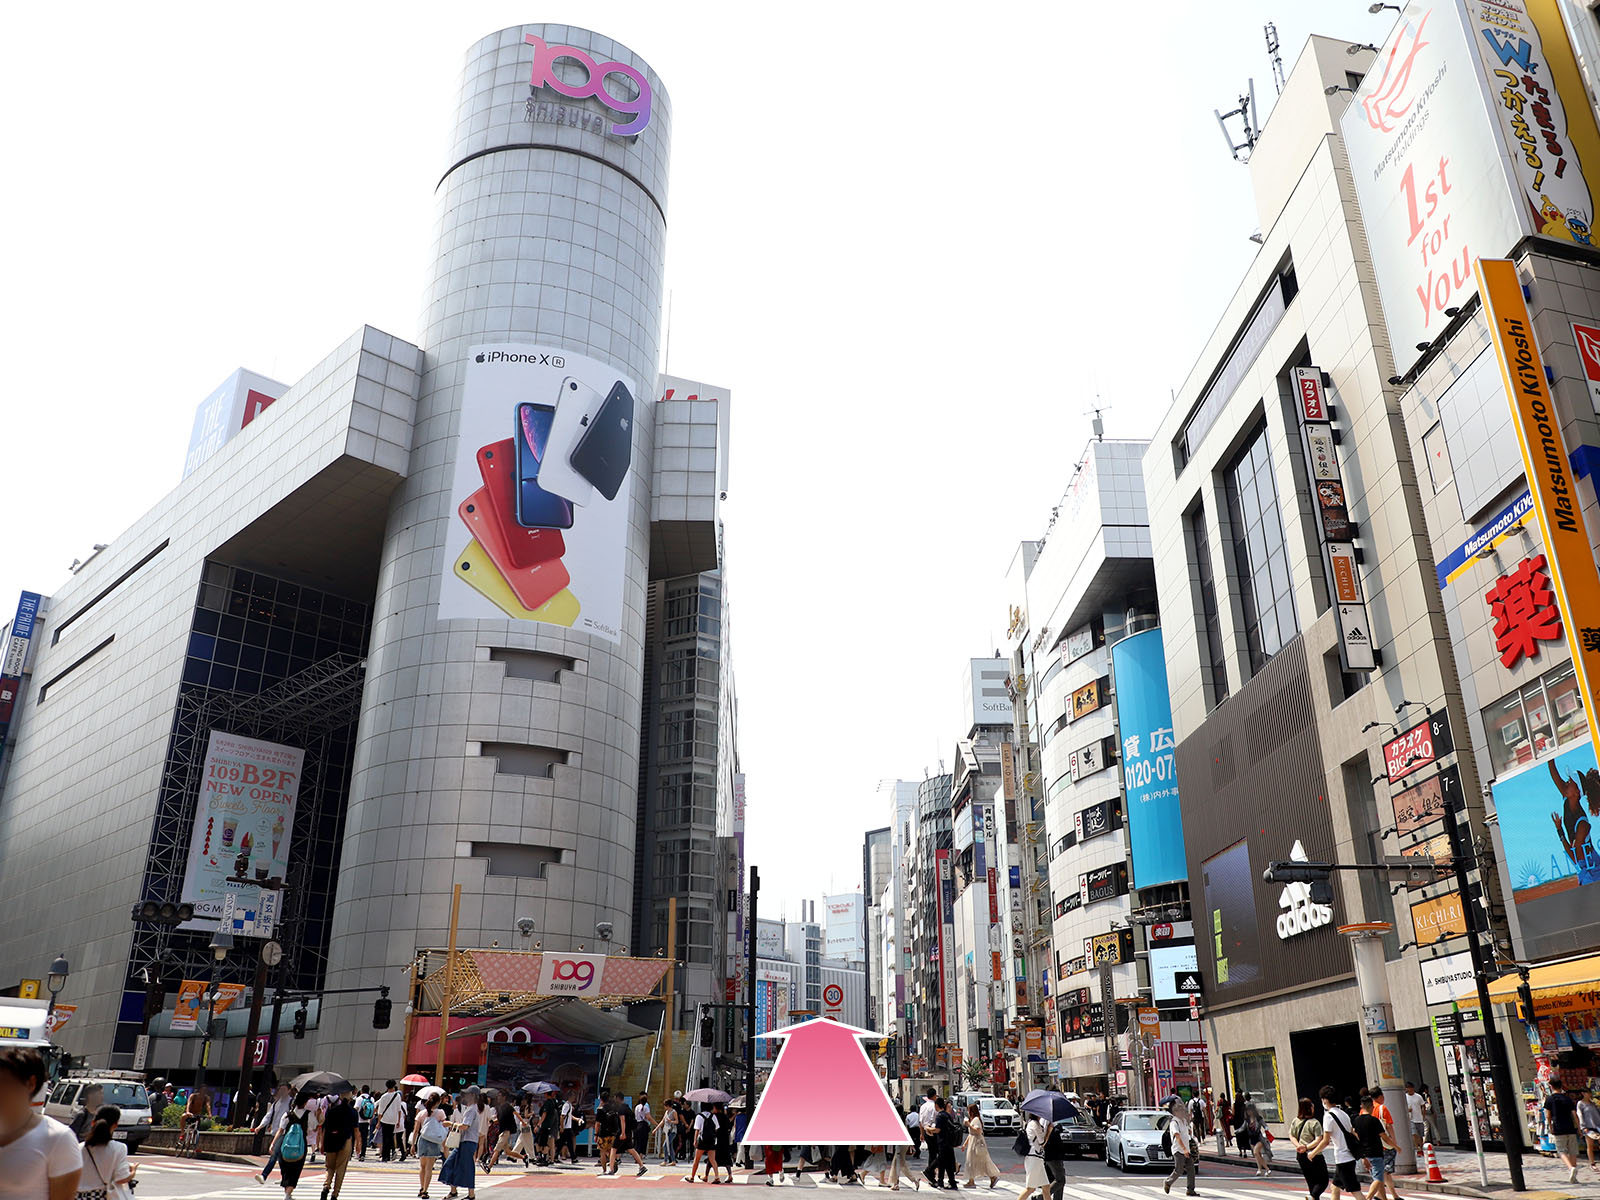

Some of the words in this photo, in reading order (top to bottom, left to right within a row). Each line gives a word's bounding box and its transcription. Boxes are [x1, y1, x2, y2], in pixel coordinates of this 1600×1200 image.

[525, 33, 651, 136] 109
[1373, 111, 1417, 182] Matsumoto
[1415, 60, 1447, 116] KiYoshi
[1393, 110, 1430, 168] Holdings
[1400, 155, 1452, 247] 1st
[1420, 213, 1450, 268] for
[1416, 244, 1471, 329] You
[487, 351, 537, 364] iPhone
[539, 354, 549, 366] X
[1504, 318, 1543, 397] KiYoshi
[1304, 381, 1319, 416] カラオケ
[1530, 399, 1578, 533] Matsumoto
[1464, 506, 1513, 558] Matsumoto
[22, 598, 36, 614] THE
[1485, 554, 1562, 669] 薬
[15, 613, 33, 637] PRIME
[593, 620, 617, 637] SoftBank
[11, 637, 19, 652] CAFE
[17, 638, 25, 661] LIVING
[13, 659, 21, 675] ROOM
[1391, 729, 1422, 757] カラオケ
[208, 764, 240, 782] 109
[240, 764, 297, 790] B2F
[1125, 754, 1177, 791] 0120-07
[206, 780, 246, 796] NEW
[249, 788, 293, 806] OPEN
[1090, 885, 1114, 900] BAGUS
[263, 894, 275, 934] 道玄坂下
[1276, 901, 1334, 940] adidas
[552, 960, 594, 990] 109
[1181, 982, 1200, 990] adidas
[1434, 974, 1455, 985] SHIBUYA
[1454, 970, 1473, 982] STUDIO
[827, 990, 839, 1000] 30
[1377, 1020, 1387, 1030] 2
